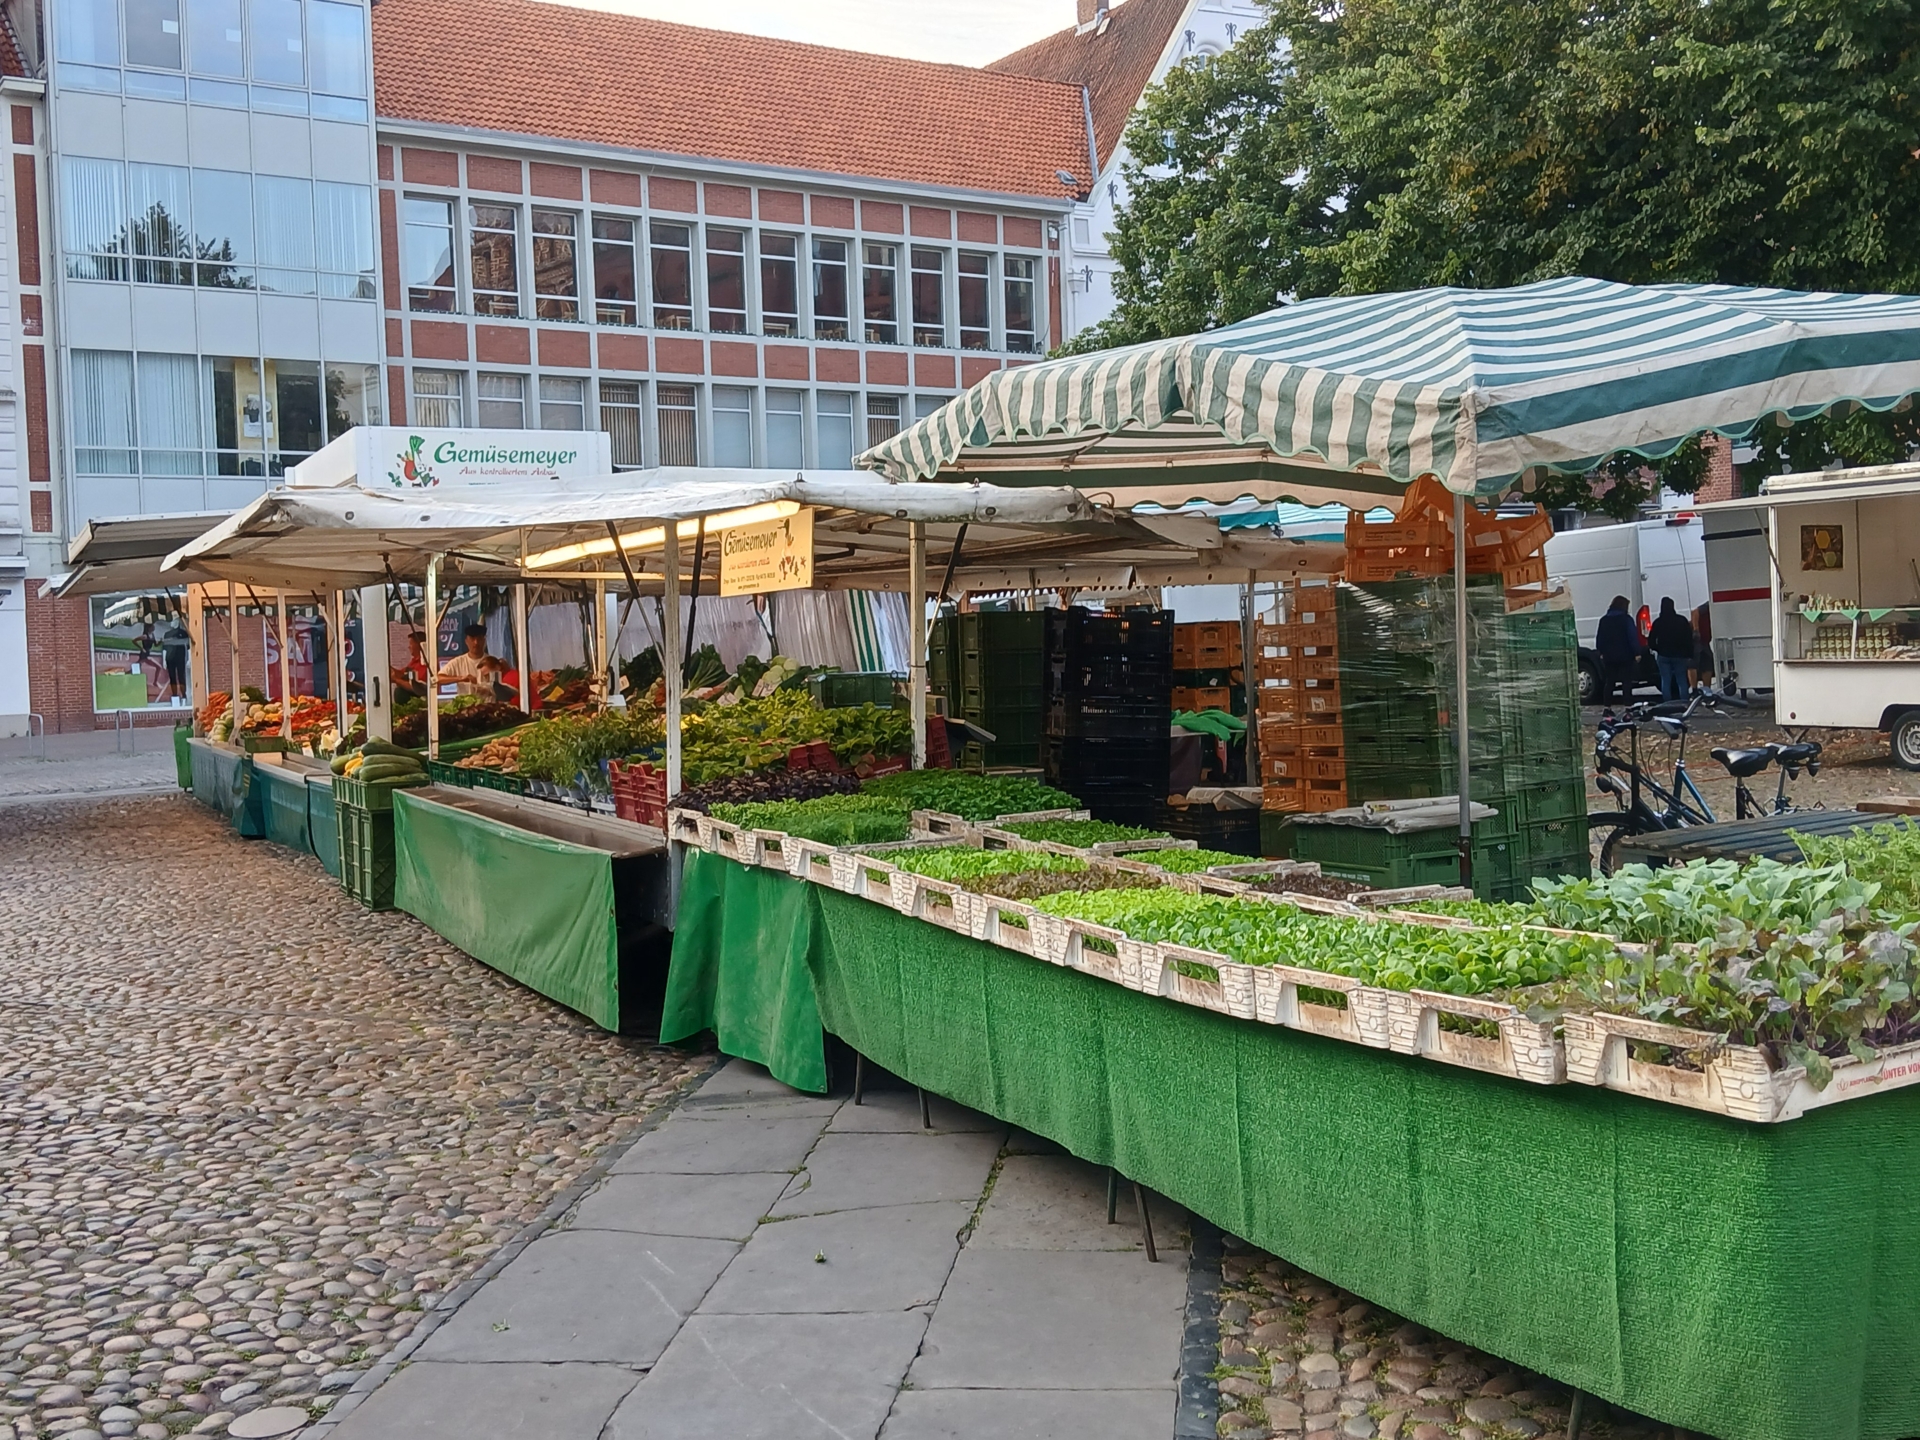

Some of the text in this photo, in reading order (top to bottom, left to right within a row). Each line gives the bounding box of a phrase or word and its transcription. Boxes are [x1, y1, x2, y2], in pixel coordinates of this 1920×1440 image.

[434, 441, 577, 468] Gemüsemeyer
[459, 466, 477, 475] Aus
[725, 530, 777, 557] Gemüsemeyer
[96, 652, 123, 661] LOCITY
